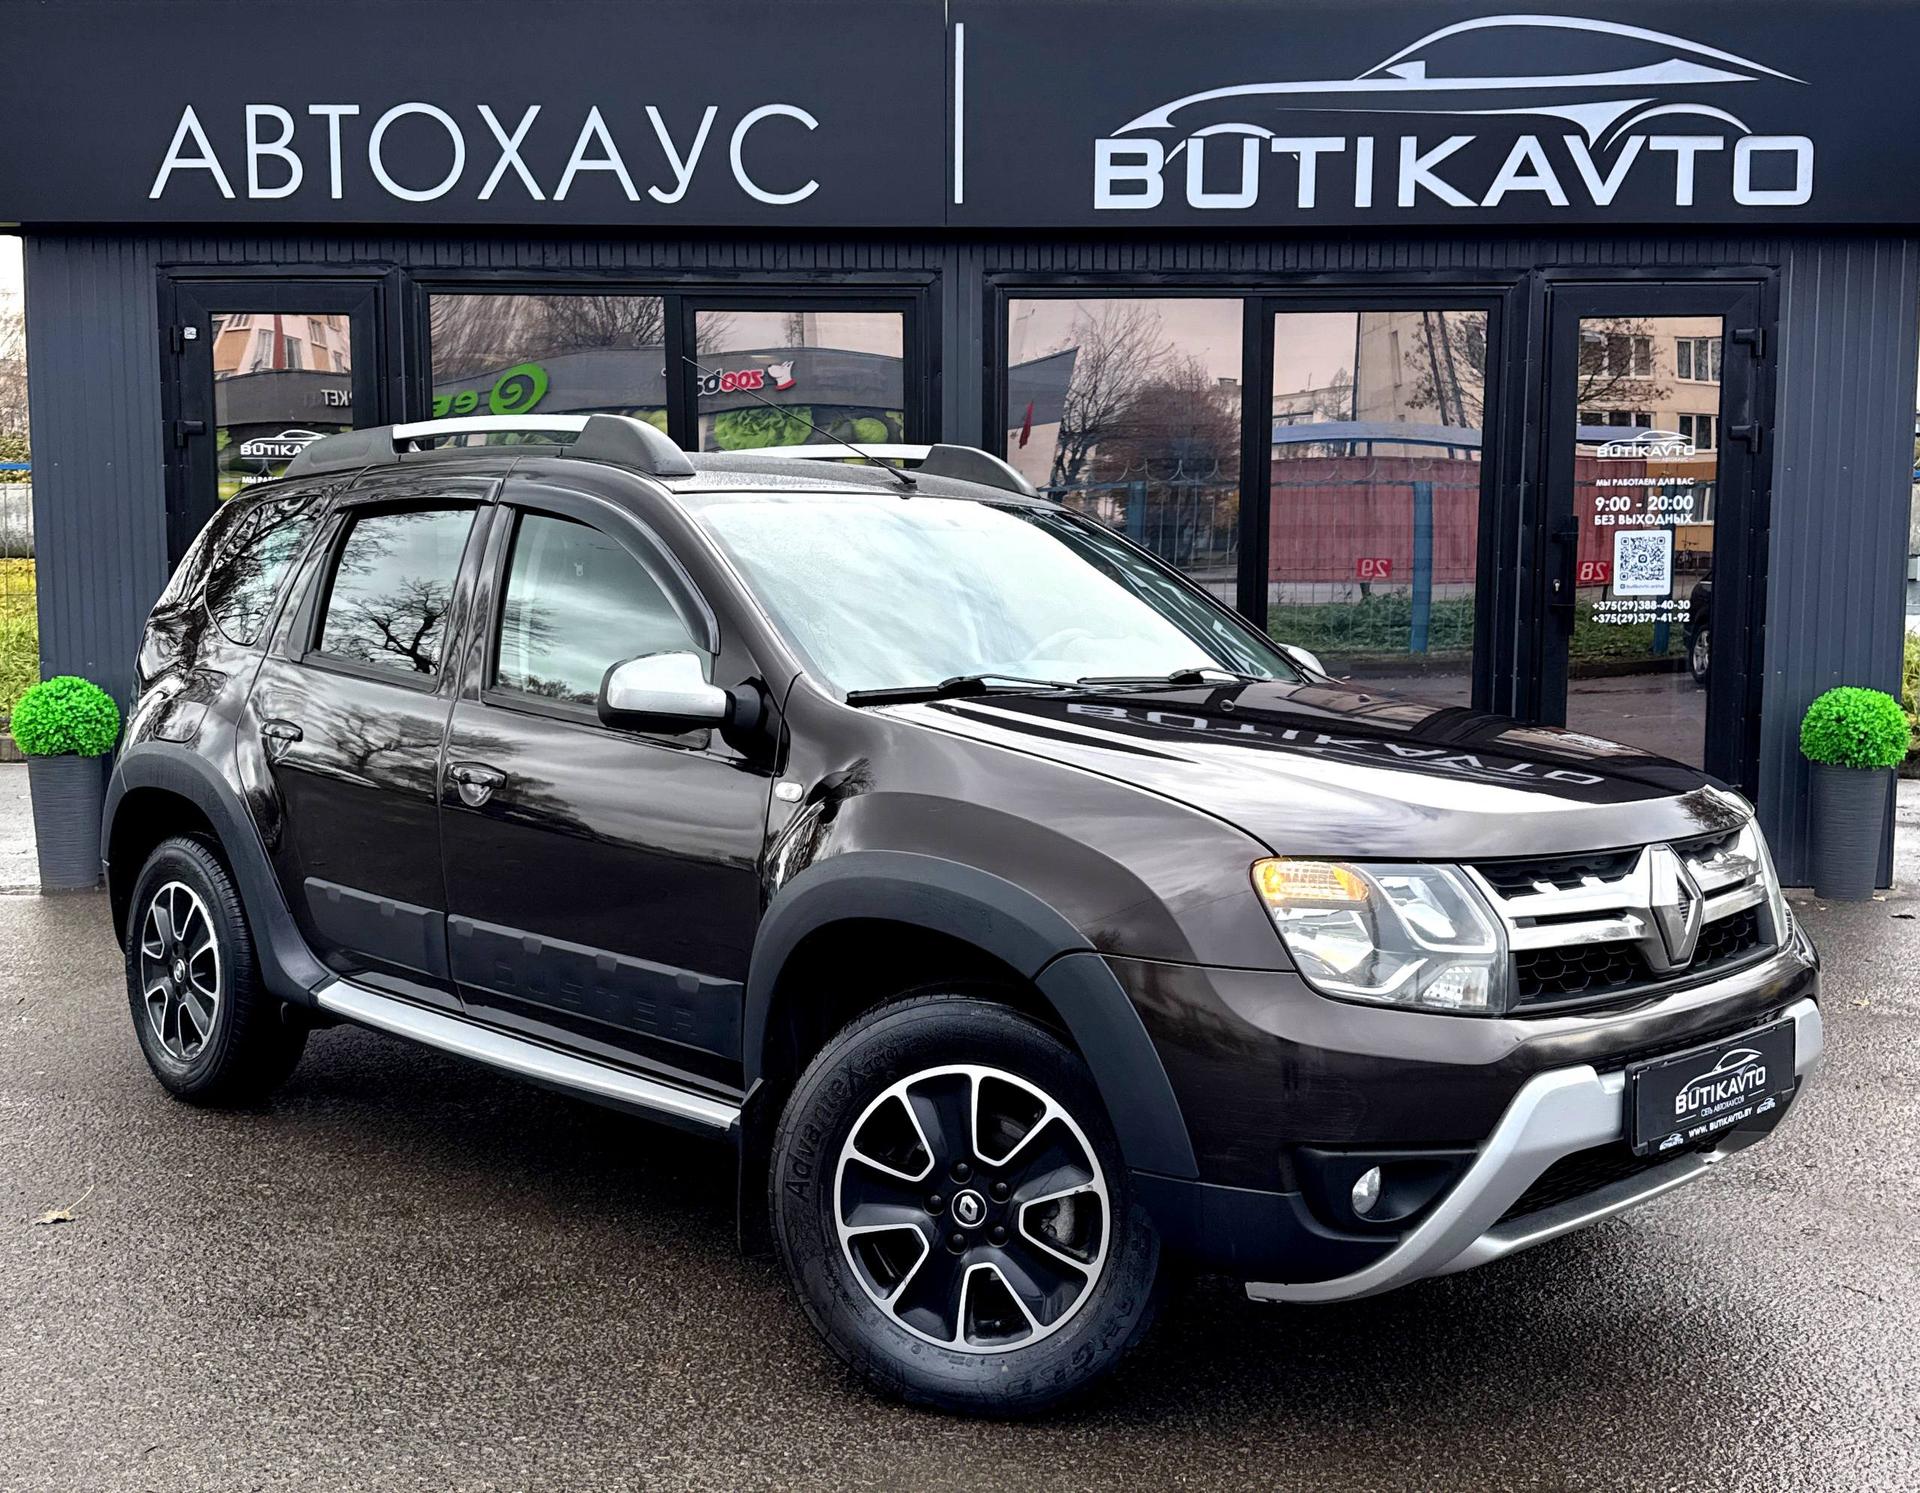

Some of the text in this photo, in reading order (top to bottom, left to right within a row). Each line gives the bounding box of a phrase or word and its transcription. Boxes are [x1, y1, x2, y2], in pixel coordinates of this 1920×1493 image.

[149, 102, 820, 204] АВТОХАУС
[1093, 133, 1814, 210] BUTIKAVTO
[240, 444, 305, 456] BUTIKA
[1597, 445, 1695, 457] BUTIKAVTO
[1612, 478, 1656, 486] РАБОТАЕМ
[1657, 478, 1675, 486] ДЛЯ
[1595, 496, 1631, 511] 9:00
[1647, 495, 1694, 511] 20:00
[1594, 513, 1693, 526] БЕЗ ВЫХОДНЫХ
[1592, 600, 1690, 612] +375(29)388-40-30
[1592, 613, 1690, 625] +375(29)379-41-92
[1675, 1066, 1766, 1115] BUTIKAVTO
